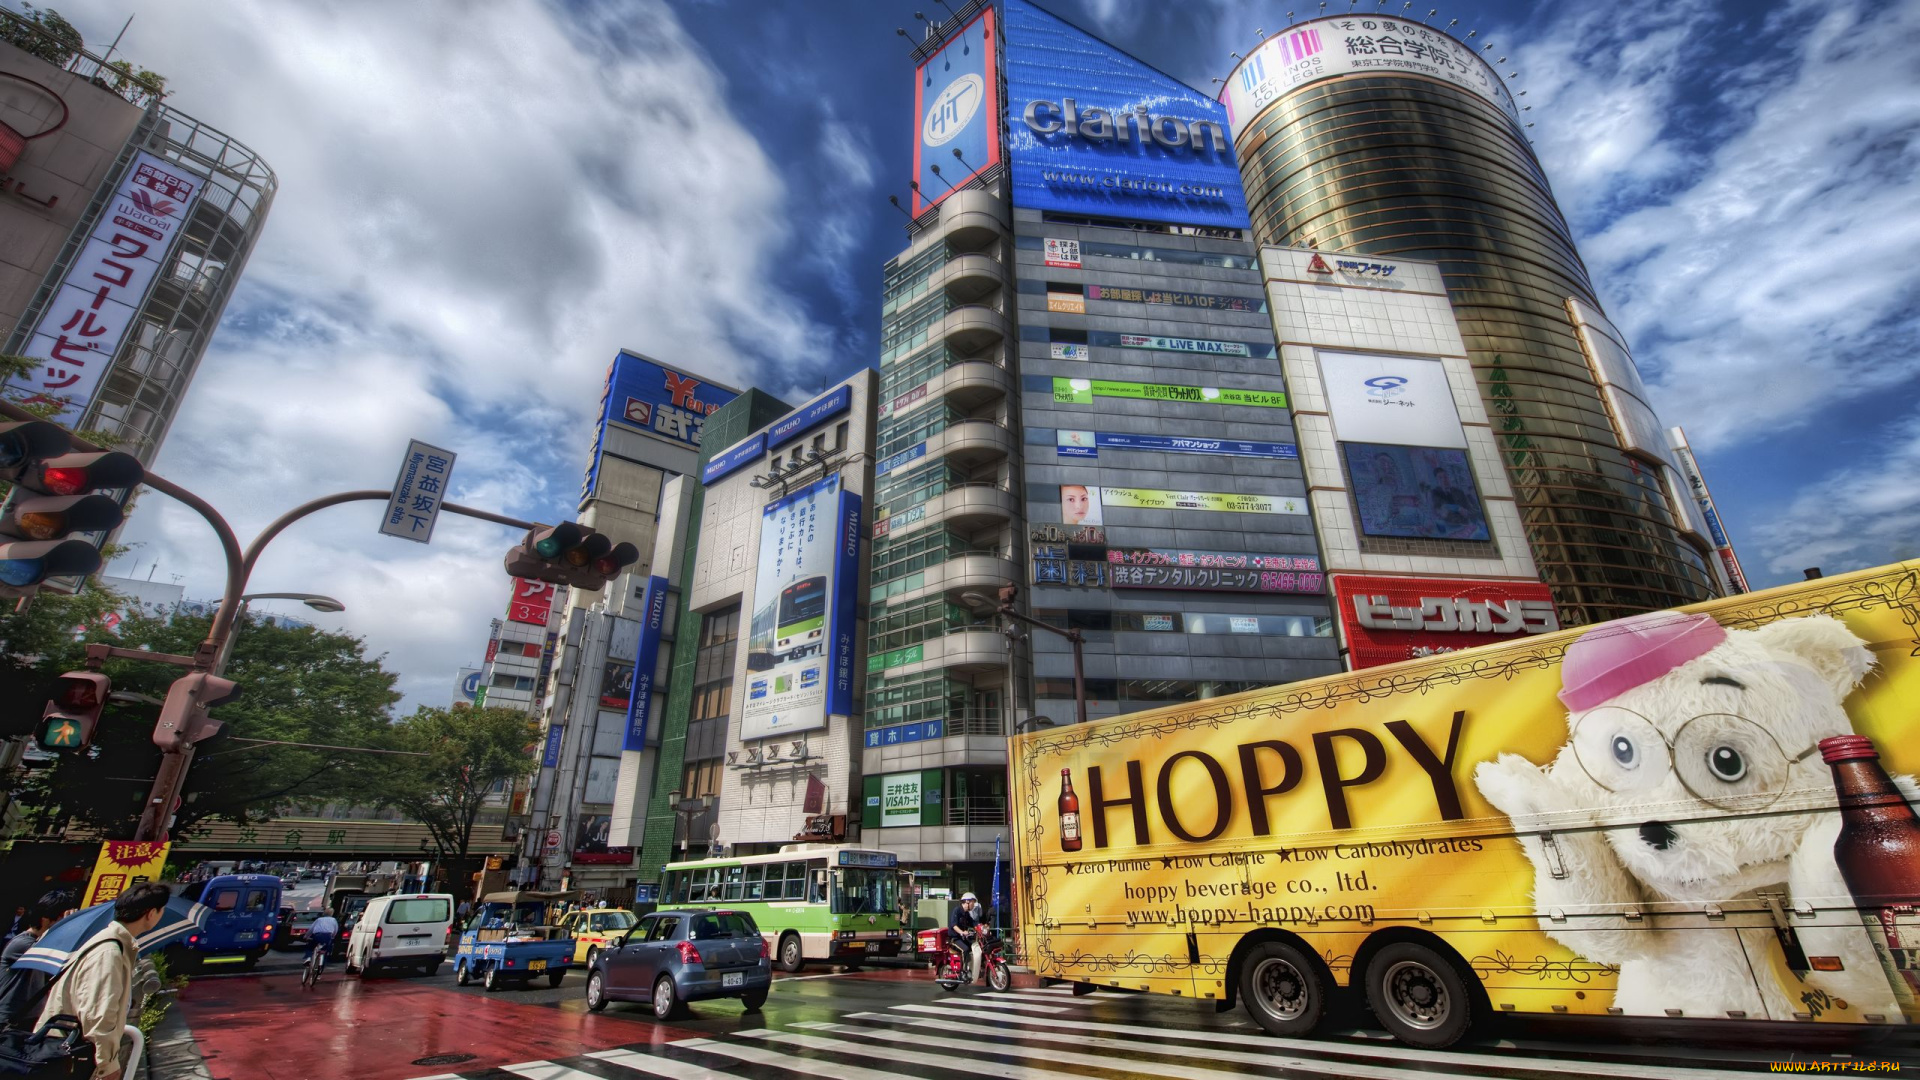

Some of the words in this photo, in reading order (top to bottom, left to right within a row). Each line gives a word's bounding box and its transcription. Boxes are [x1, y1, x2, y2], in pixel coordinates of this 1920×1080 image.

[1023, 97, 1226, 153] clarion
[1042, 169, 1224, 199] www.clarion.com
[1197, 341, 1223, 353] MAX
[773, 417, 801, 437] MIZUHO
[397, 451, 425, 505] Miyamasuzaka
[706, 459, 726, 474] MIZUHO
[407, 454, 448, 533] 宮益坂下
[847, 509, 858, 557] MIZUHO
[1115, 566, 1259, 589] 渋谷デンタルクリニック
[650, 589, 664, 630] MIZUHO
[1353, 594, 1561, 634] ビックカメラ
[632, 674, 649, 736] みずほ信託銀行
[887, 782, 919, 796] 三井住友
[1087, 710, 1466, 848] HOPPY
[885, 794, 920, 807] VISAカード
[116, 843, 160, 860] 注意!
[237, 828, 347, 845] 渋谷駅
[1076, 862, 1105, 875] Zero
[1109, 859, 1151, 873] Purine
[1174, 856, 1204, 869] Low
[1209, 851, 1265, 868] Calorie
[1292, 847, 1329, 862] Low
[1335, 838, 1483, 860] Carbohydrates
[93, 876, 124, 905] 衝突
[1124, 882, 1178, 903] hoppy
[1185, 879, 1277, 900] beverage
[1336, 870, 1378, 892] ltd.
[1127, 902, 1375, 926] www.hoppy-happy.com
